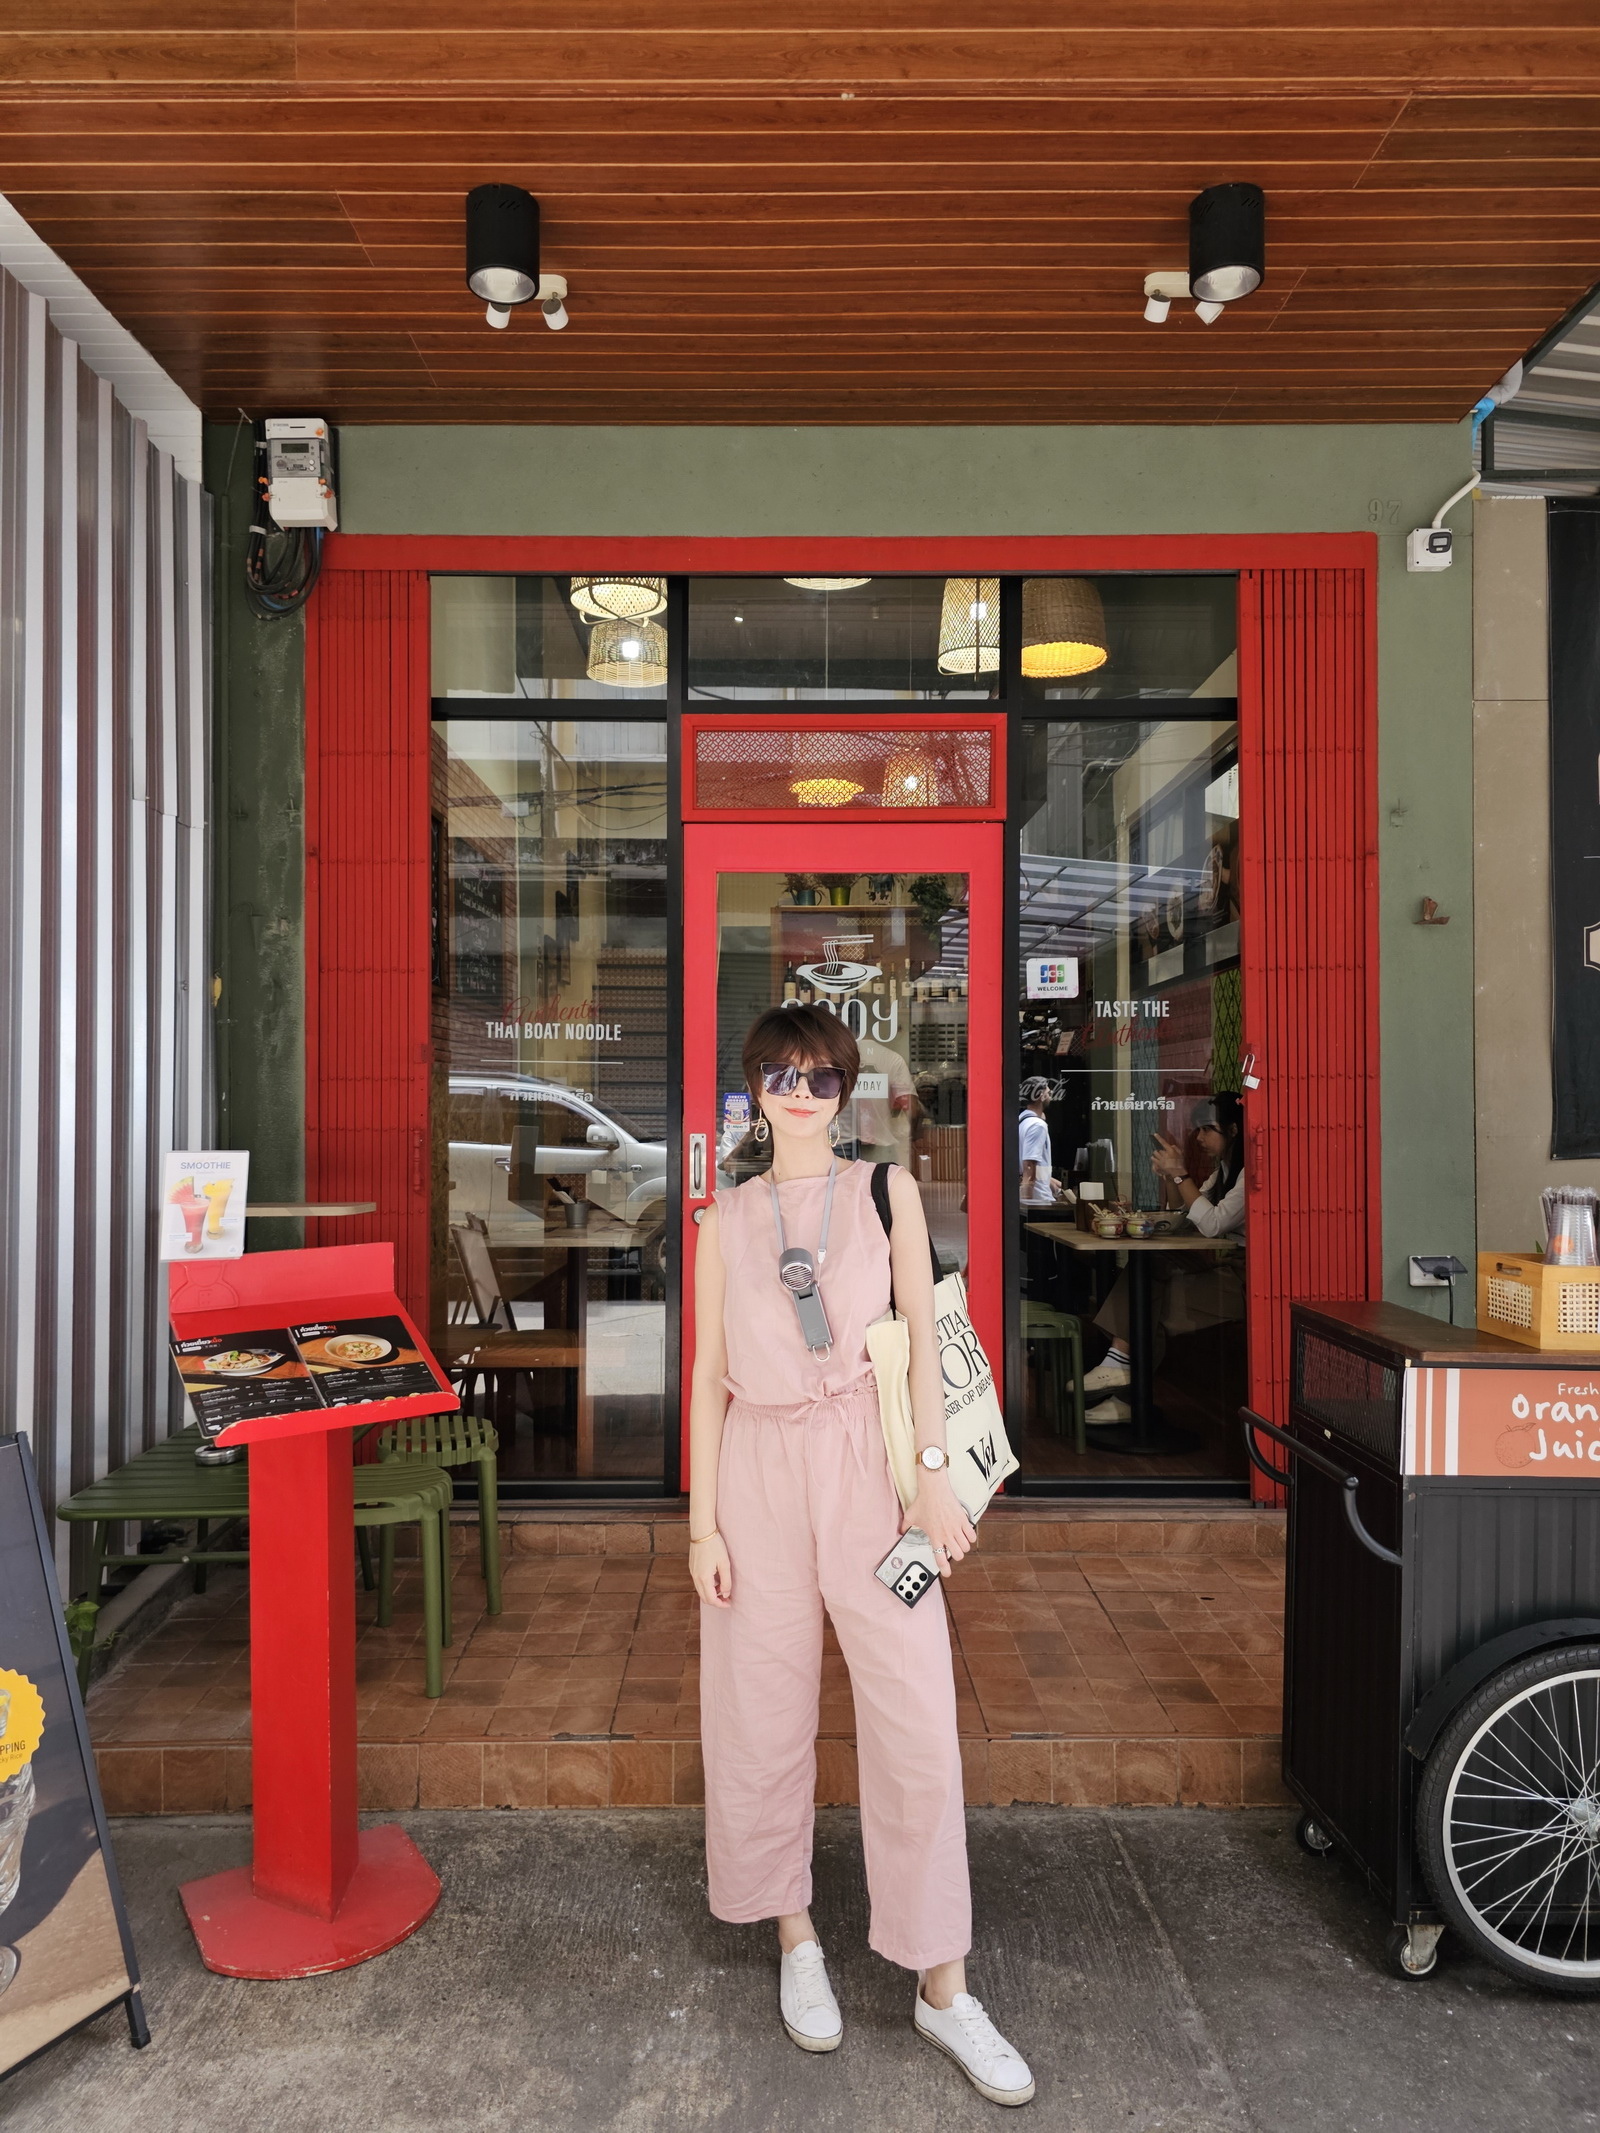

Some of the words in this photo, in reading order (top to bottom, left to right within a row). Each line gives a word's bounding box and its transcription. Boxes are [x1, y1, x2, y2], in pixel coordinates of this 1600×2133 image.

[1368, 498, 1402, 525] 97
[1040, 968, 1065, 980] JCB
[1095, 1001, 1138, 1018] TASTE
[1143, 1001, 1170, 1018] THE
[486, 1021, 519, 1039] THAI
[524, 1022, 560, 1039] BOAT
[565, 1023, 622, 1040] NOODLE
[856, 1081, 882, 1091] YDAY
[1091, 1092, 1175, 1111] ก๋วยเตี๋ยวเรือ
[940, 1331, 988, 1399] OR
[944, 1400, 963, 1420] NER
[962, 1389, 976, 1406] OF
[975, 1371, 994, 1397] DREAM
[1558, 1382, 1600, 1395] Fresh
[1512, 1393, 1600, 1424] Oran
